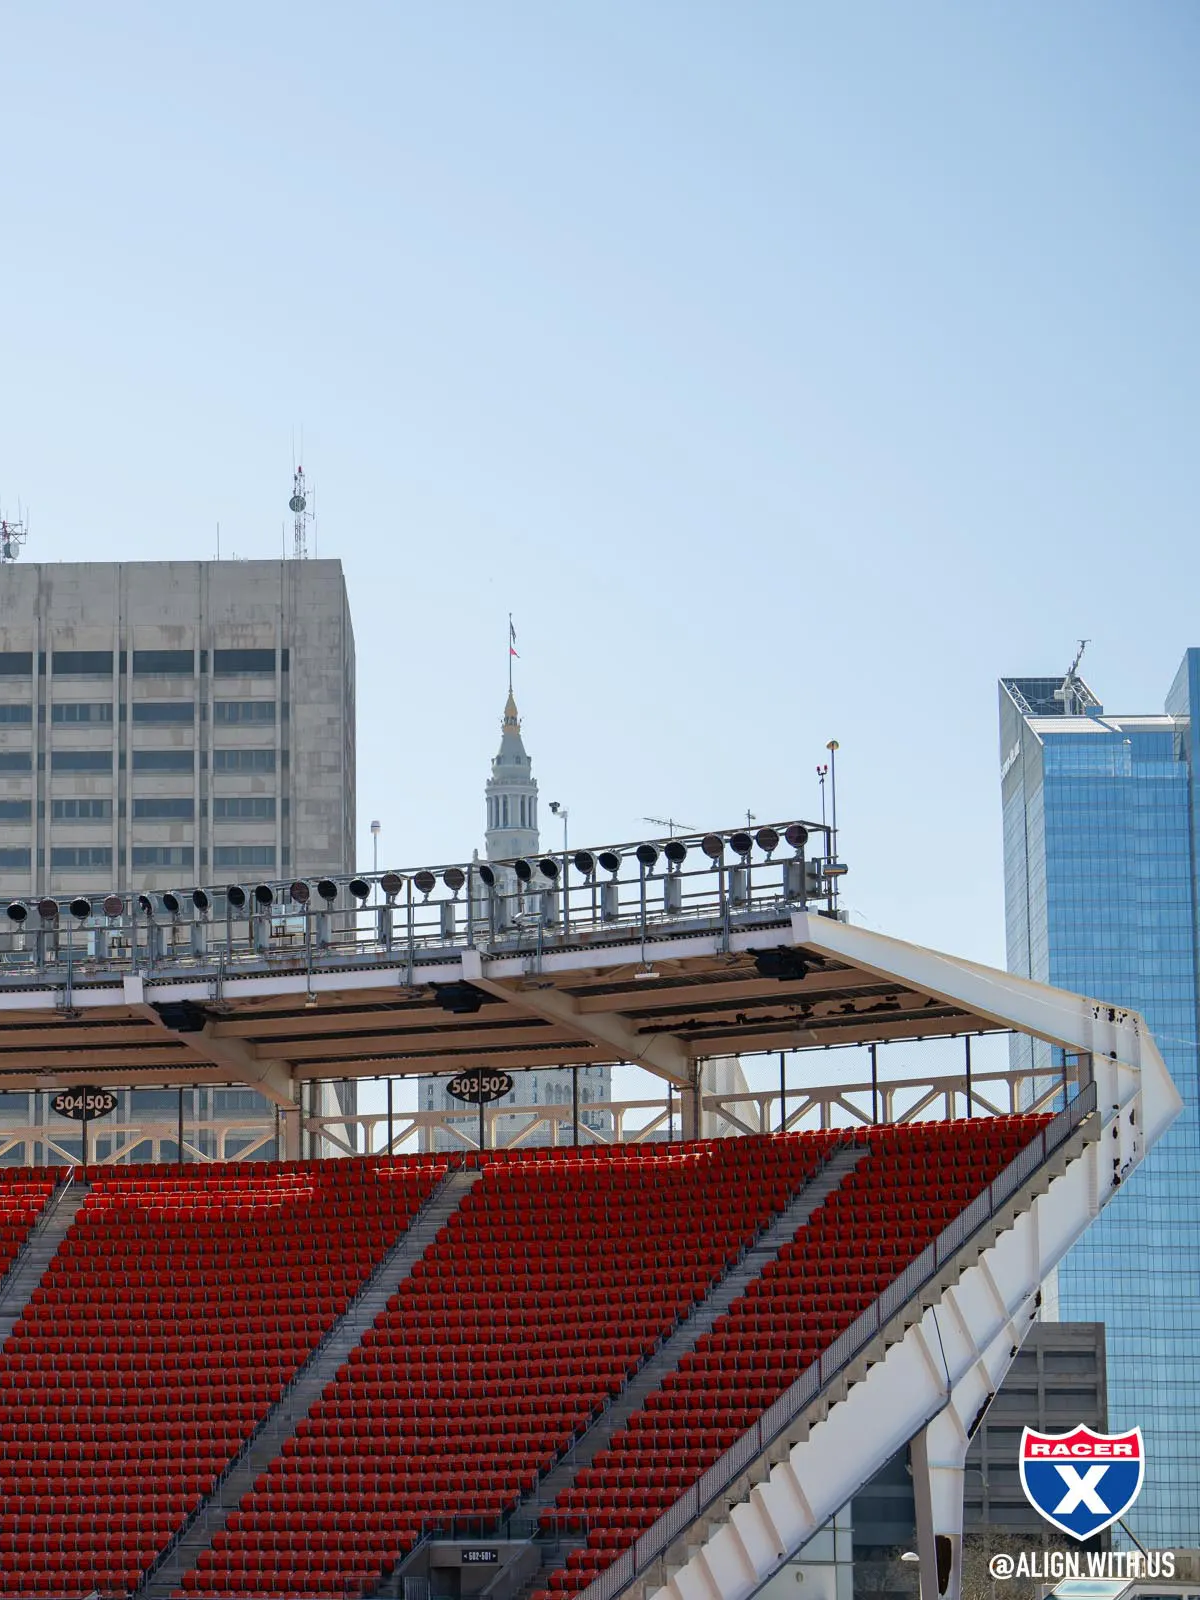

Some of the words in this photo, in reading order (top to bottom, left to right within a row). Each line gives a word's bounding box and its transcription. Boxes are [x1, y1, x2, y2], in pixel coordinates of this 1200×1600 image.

[452, 1078, 479, 1094] 503
[481, 1076, 508, 1092] 502
[55, 1095, 83, 1110] 504
[86, 1094, 113, 1109] 503
